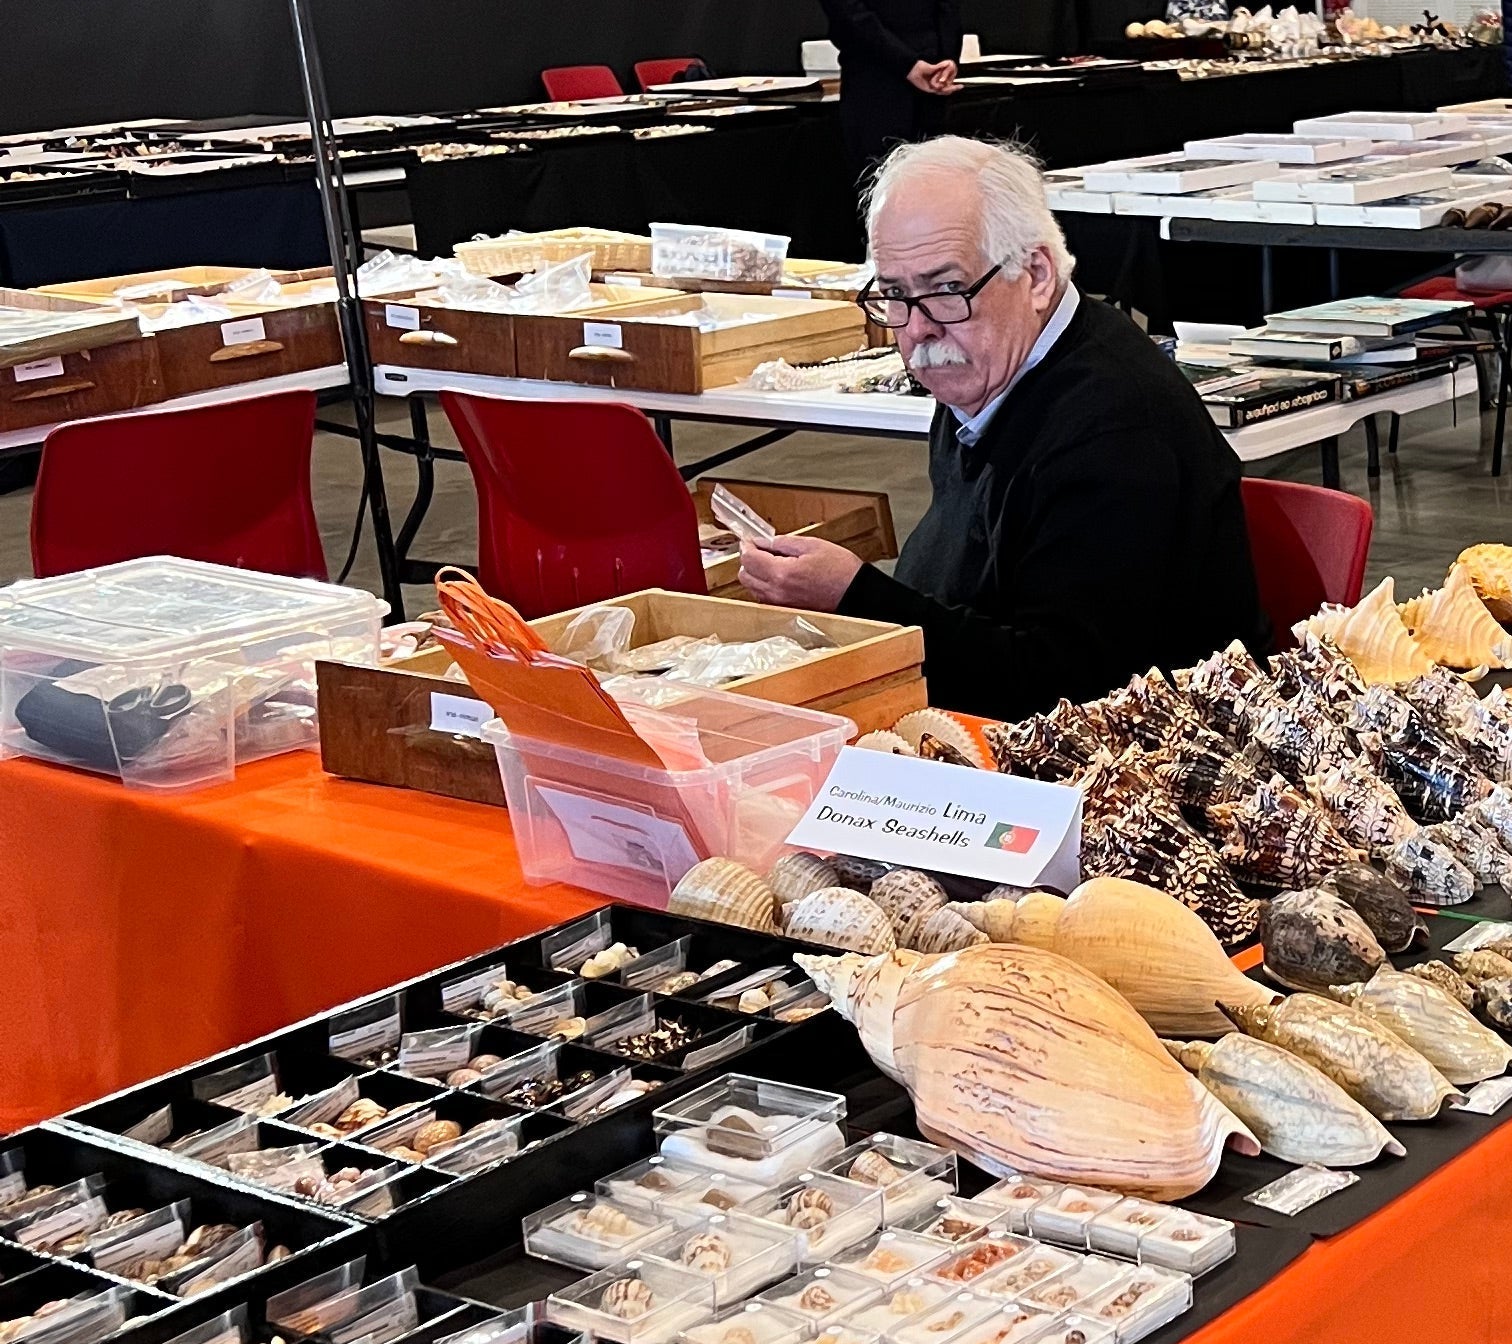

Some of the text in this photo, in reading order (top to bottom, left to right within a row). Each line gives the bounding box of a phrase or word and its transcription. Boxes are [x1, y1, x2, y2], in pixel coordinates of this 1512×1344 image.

[829, 785, 987, 825] Carolina/Maurizio Lima
[816, 805, 971, 848] Donax Seashells
